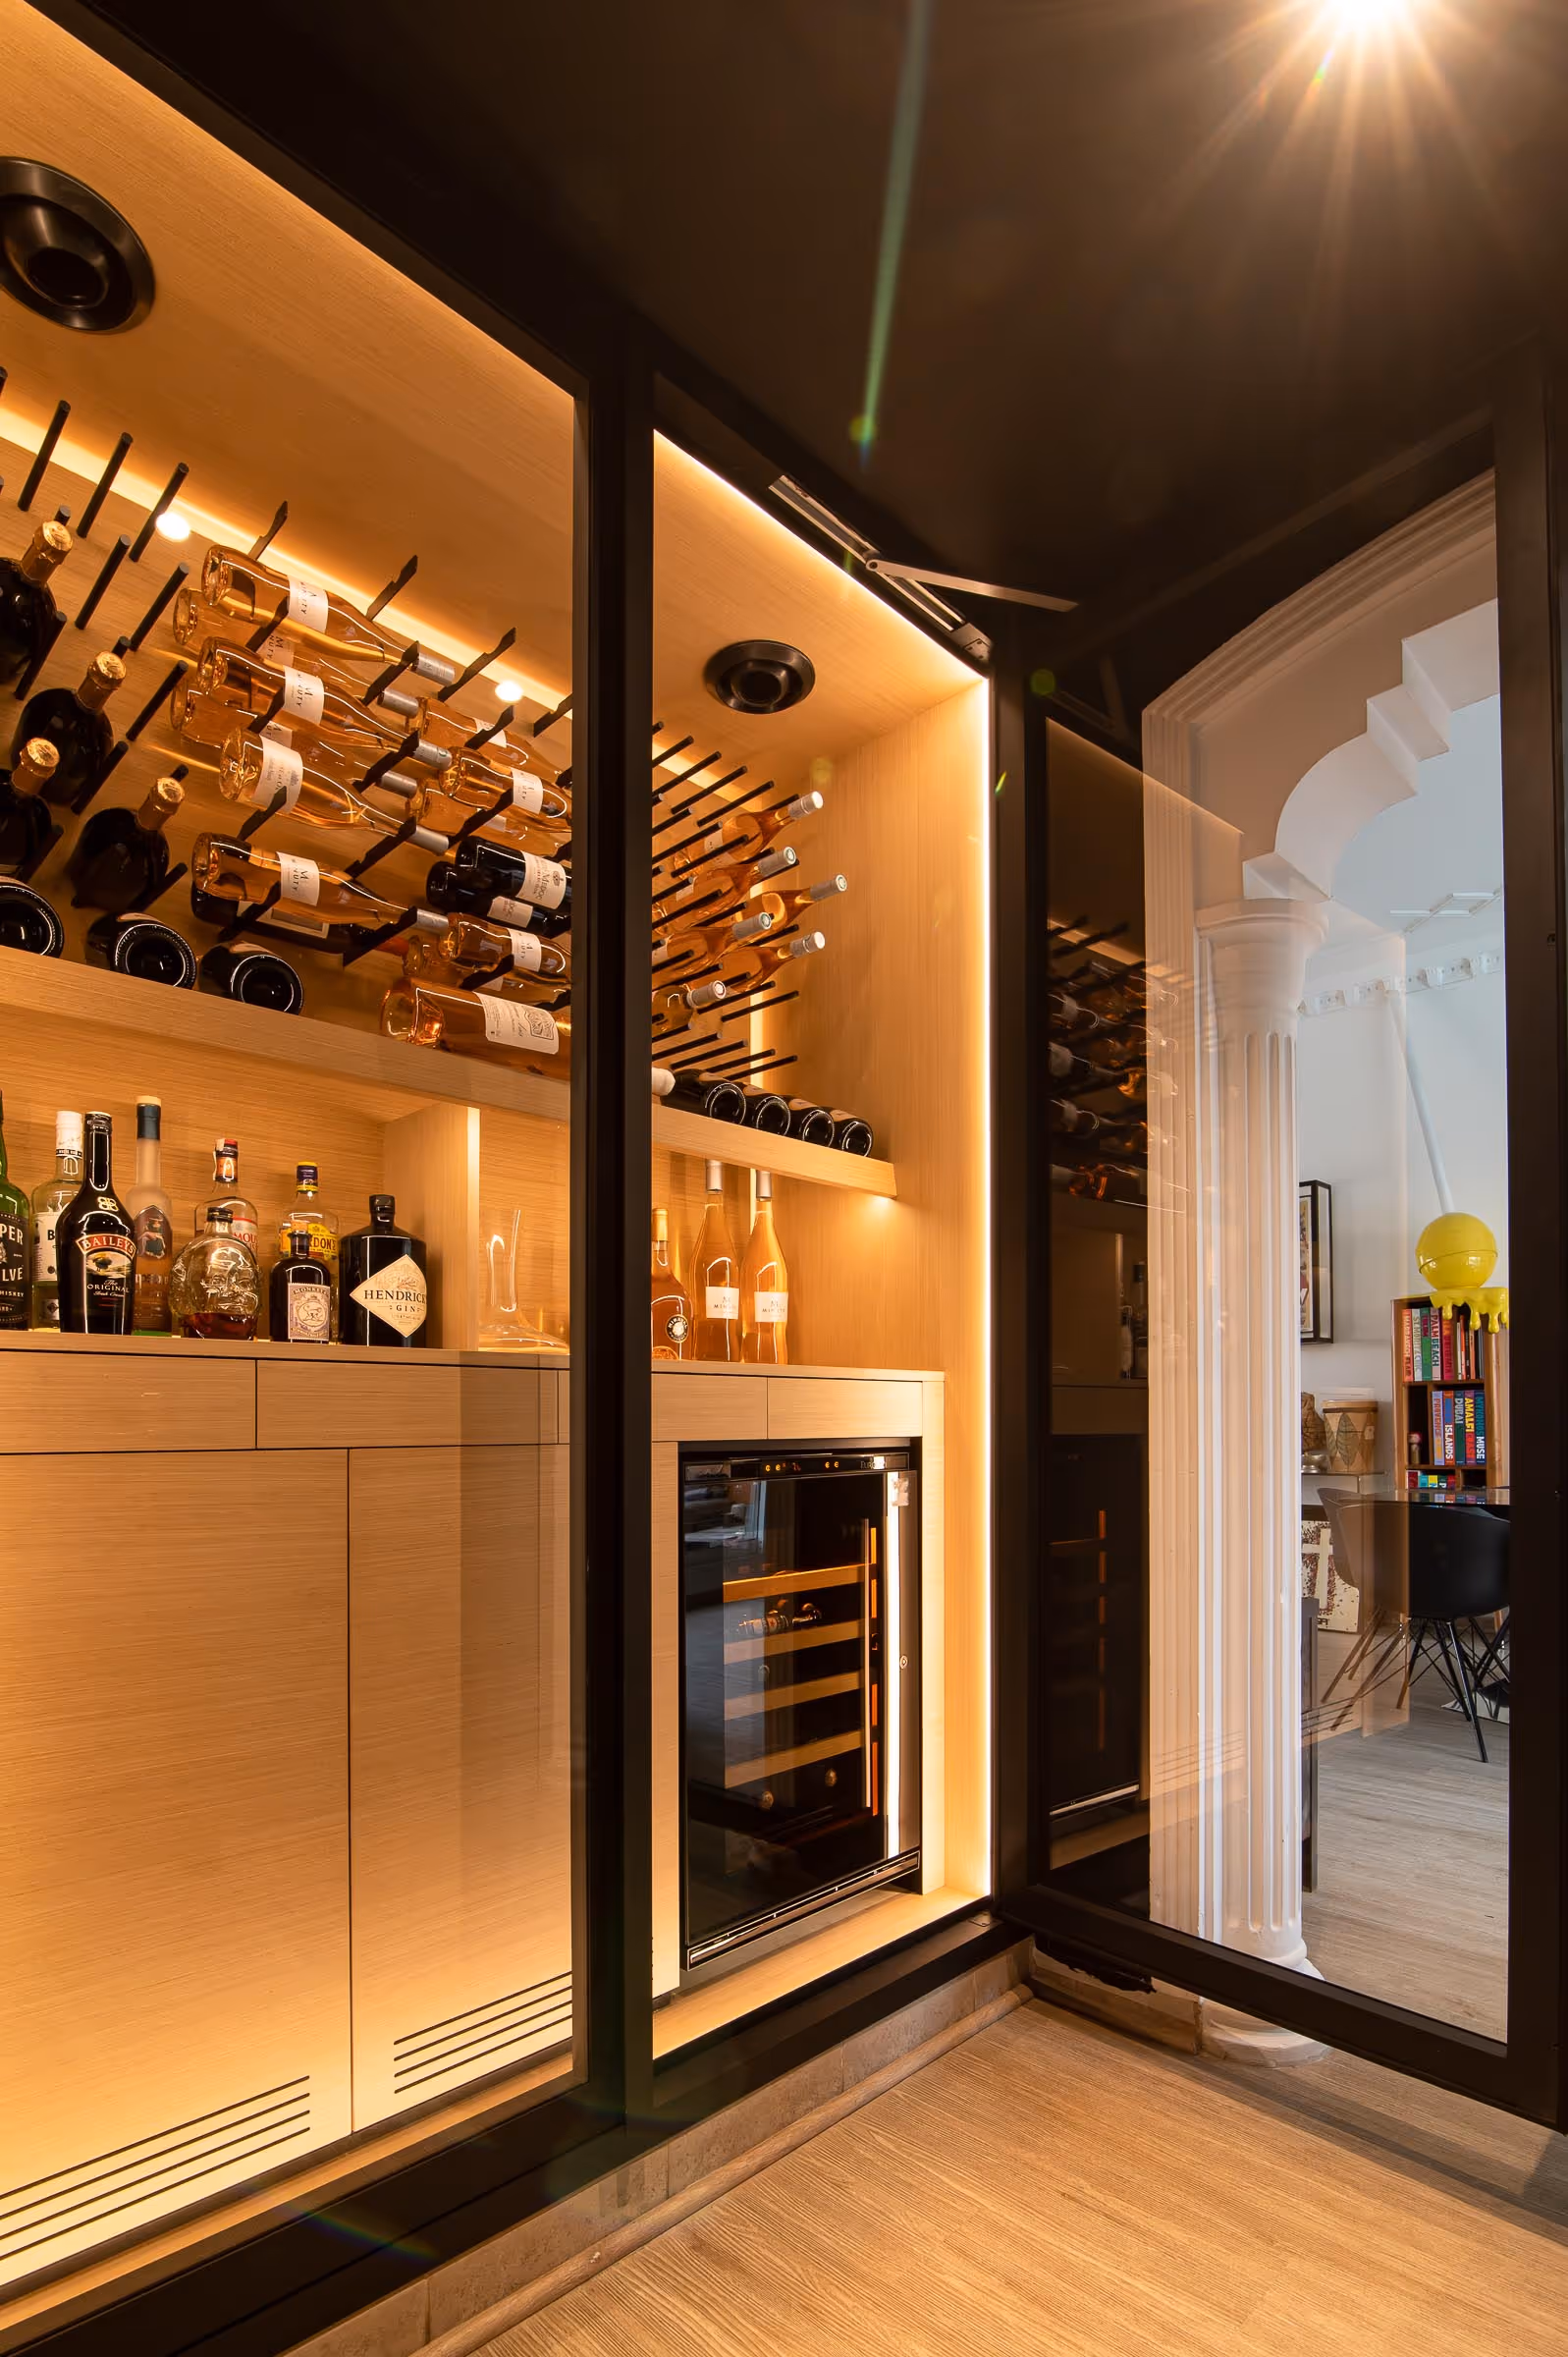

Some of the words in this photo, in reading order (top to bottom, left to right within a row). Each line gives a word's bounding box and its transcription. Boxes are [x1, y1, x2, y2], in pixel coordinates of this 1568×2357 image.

[81, 1236, 135, 1254] BAILEYS
[86, 1284, 130, 1293] ORIGINAL
[396, 1304, 416, 1313] GIN
[1431, 1315, 1439, 1338] PALM
[1432, 1338, 1440, 1366] BEACH
[1454, 1398, 1464, 1424] DUBAI
[1465, 1398, 1475, 1432] AMALFI
[1444, 1424, 1453, 1459] ISLANDS
[1476, 1436, 1486, 1459] MUSE
